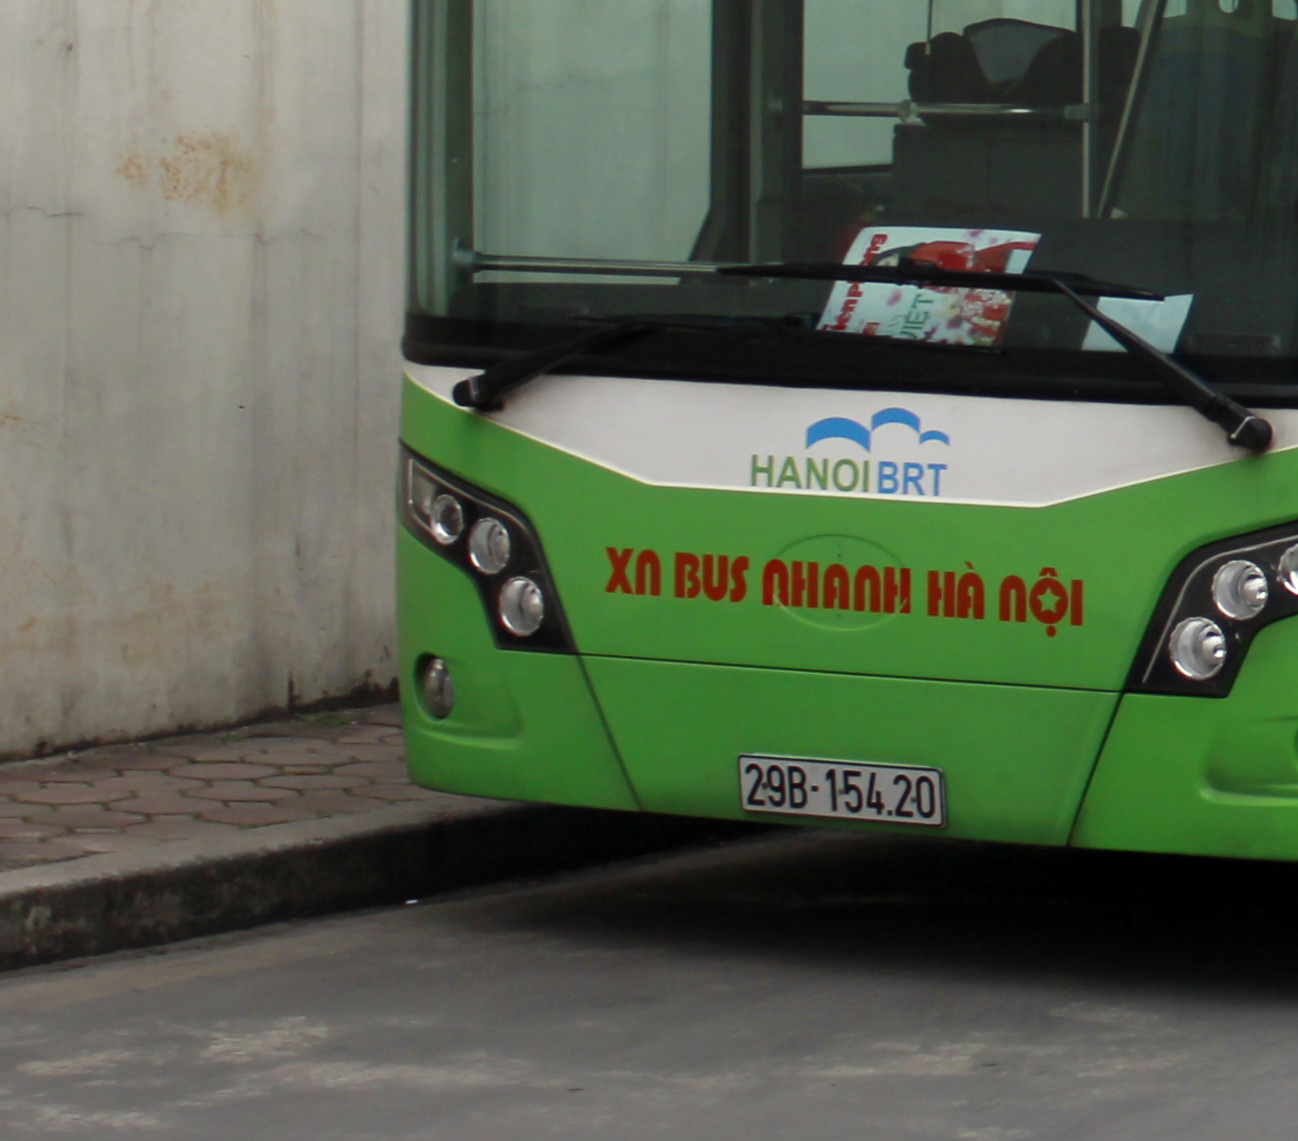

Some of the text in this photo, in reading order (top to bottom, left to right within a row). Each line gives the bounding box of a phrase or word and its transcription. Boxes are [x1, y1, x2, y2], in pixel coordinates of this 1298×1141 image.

[605, 547, 1084, 637] XN BUS NHANH HÀ NỘI
